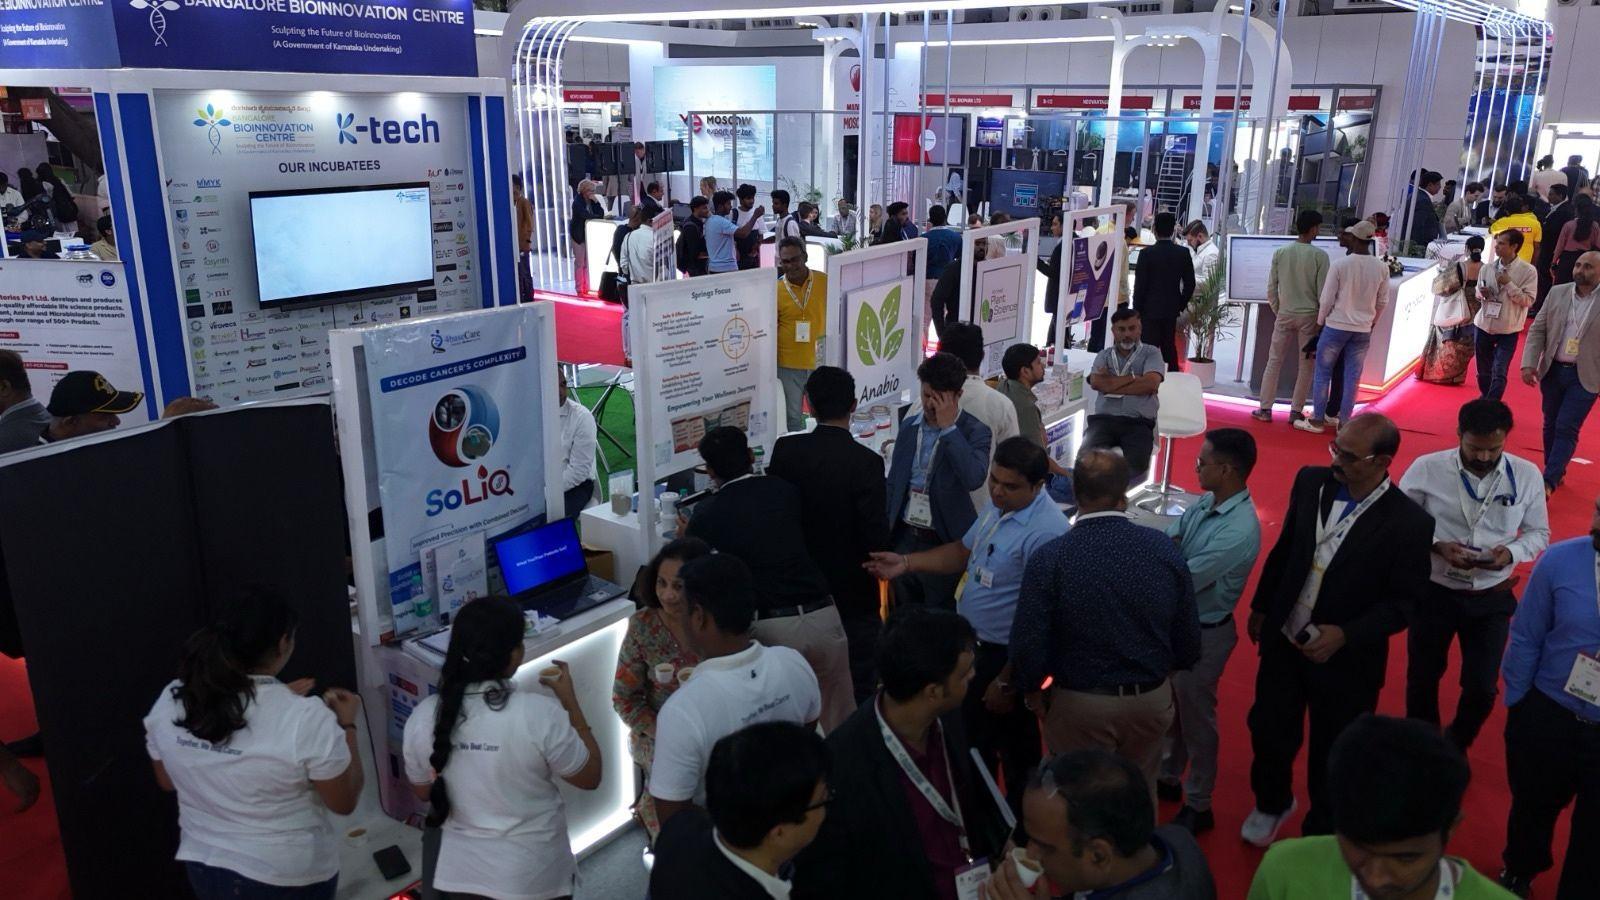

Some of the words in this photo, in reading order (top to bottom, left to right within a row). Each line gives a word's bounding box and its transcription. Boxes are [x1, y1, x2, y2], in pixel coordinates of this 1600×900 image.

[290, 0, 408, 20] BIOINNOVATION
[412, 8, 464, 24] CENTRE
[271, 26, 306, 36] Sculpting
[307, 28, 320, 36] the
[321, 28, 344, 36] Future
[282, 40, 324, 50] Government
[233, 123, 314, 132] BIOINNOVATION
[336, 112, 440, 144] K-tech
[844, 116, 860, 130] MOSC
[256, 133, 296, 142] CENTRE
[278, 162, 306, 173] OUR
[308, 160, 380, 172] INCUBATEES
[691, 289, 713, 301] Springs
[714, 287, 731, 296] Focus
[390, 373, 427, 388] DECODE
[430, 362, 471, 379] CANCER'S
[473, 351, 522, 368] COMPLEXITY
[859, 374, 899, 403] Anabio
[667, 397, 700, 412] Empowering
[702, 395, 714, 404] Your
[714, 390, 737, 400] Wellness
[737, 384, 756, 395] Journey
[413, 533, 440, 548] Improved
[440, 526, 468, 540] Precision
[469, 521, 483, 530] with
[483, 512, 509, 526] Combined
